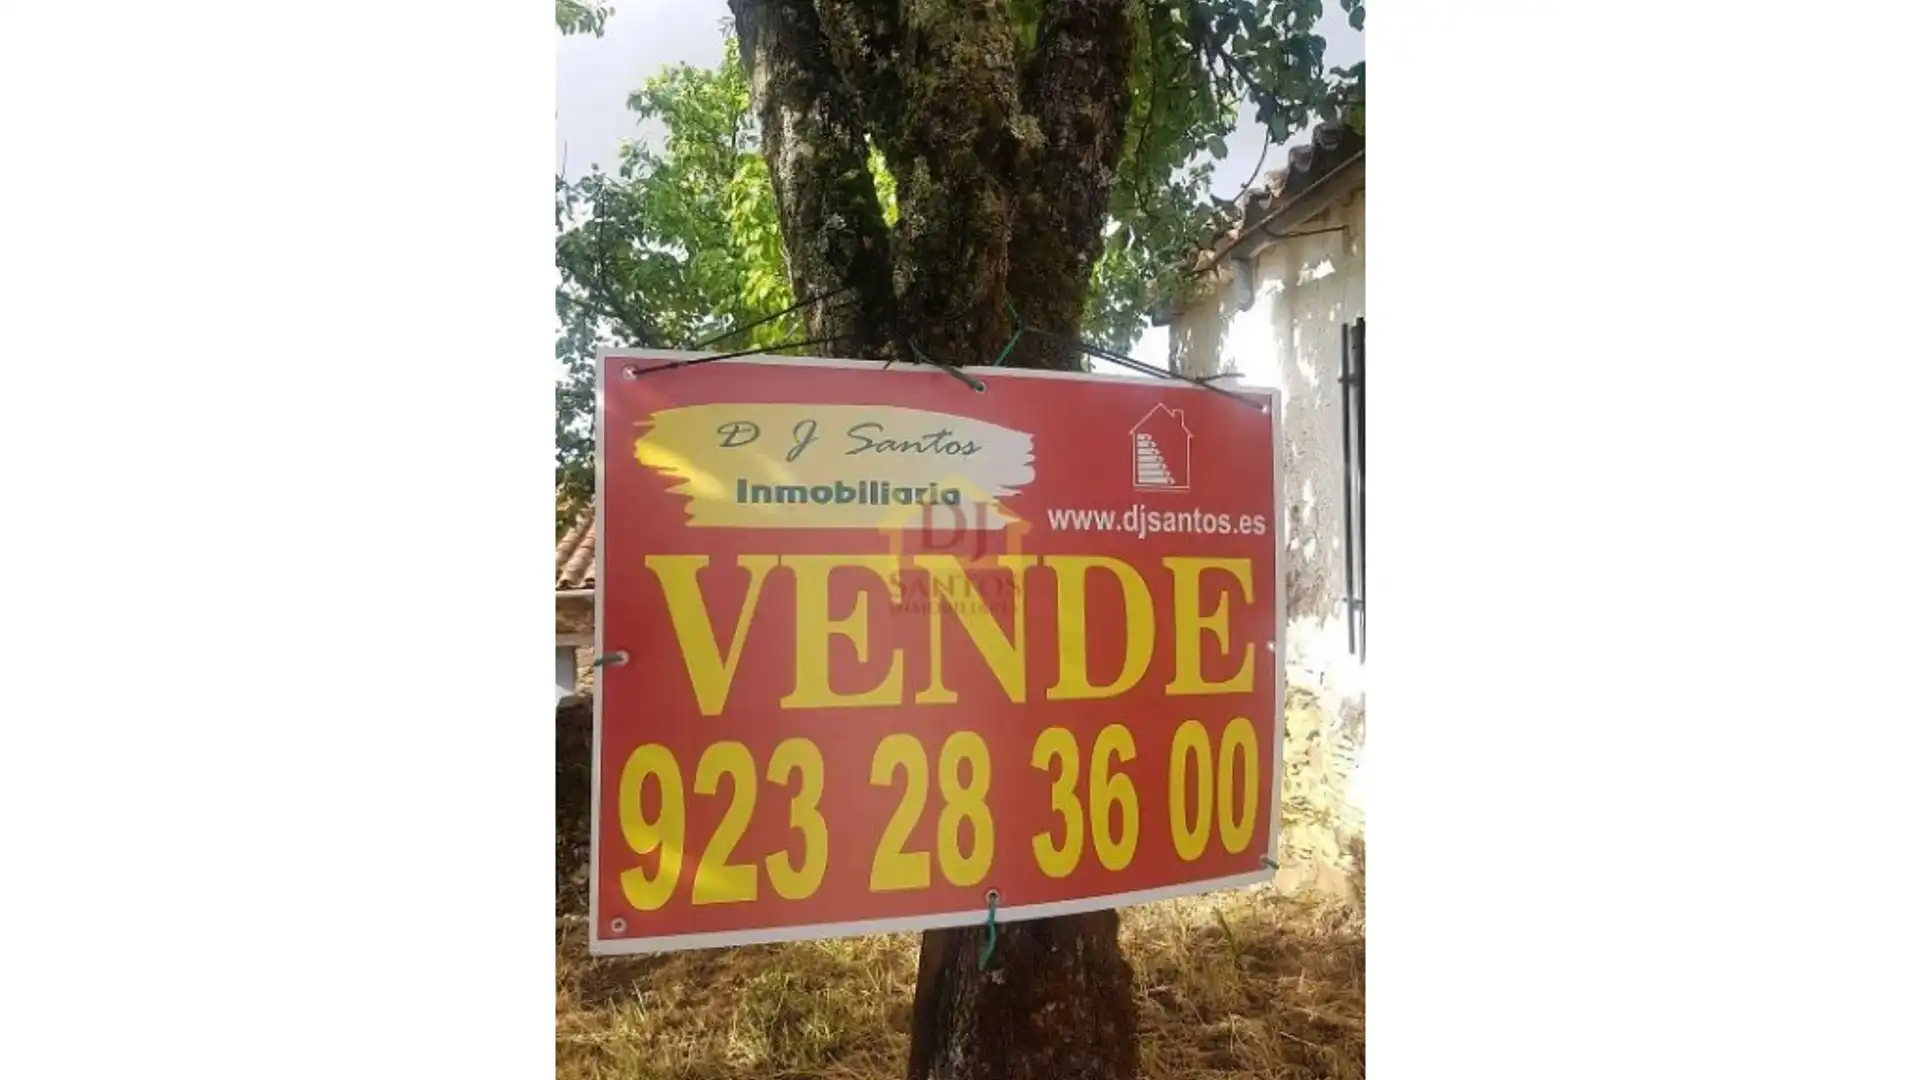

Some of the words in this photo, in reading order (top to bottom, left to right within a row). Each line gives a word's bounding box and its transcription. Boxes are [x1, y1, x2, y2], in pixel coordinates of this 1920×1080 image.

[717, 422, 758, 448] D
[846, 423, 982, 457] Santos
[736, 479, 961, 506] Inmobiliaria
[1047, 504, 1267, 540] www.djsantos.es
[645, 554, 1255, 716] VENDE
[618, 738, 828, 911] 923
[869, 731, 995, 893] 28
[1031, 723, 1140, 879] 36
[1169, 717, 1259, 862] 00
